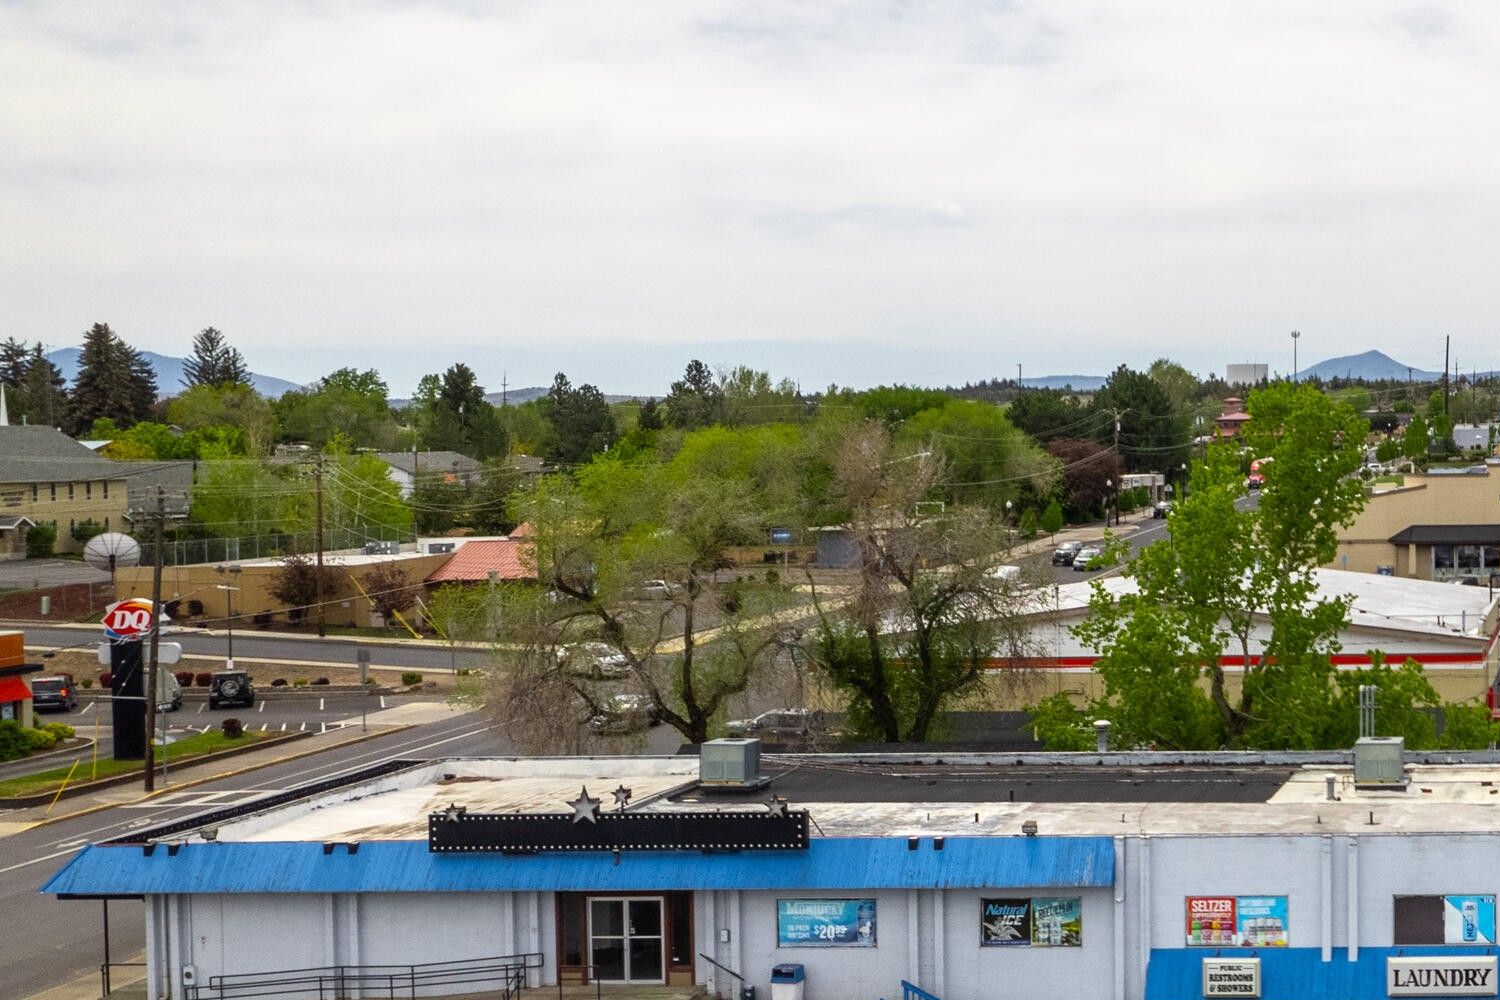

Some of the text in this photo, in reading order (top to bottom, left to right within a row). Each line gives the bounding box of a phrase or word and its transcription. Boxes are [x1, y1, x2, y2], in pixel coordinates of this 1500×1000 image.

[112, 610, 150, 630] DQ
[986, 904, 1028, 916] Natural
[1191, 900, 1233, 912] SELTZER
[1001, 915, 1025, 926] ICE
[1208, 973, 1253, 982] RESTROOMS
[1393, 968, 1492, 987] LAUNDRY
[1217, 984, 1253, 992] SHOWERS
